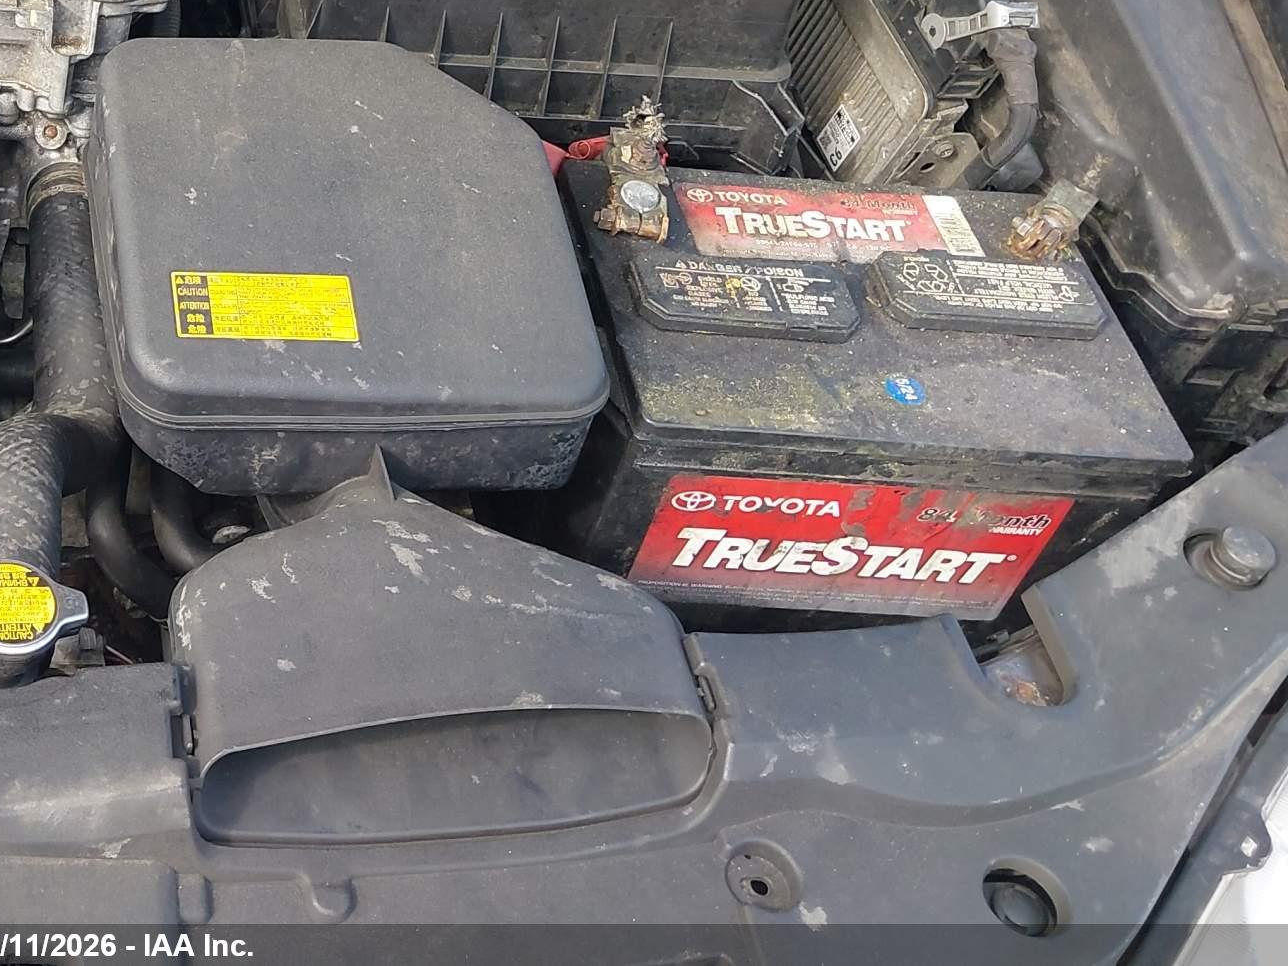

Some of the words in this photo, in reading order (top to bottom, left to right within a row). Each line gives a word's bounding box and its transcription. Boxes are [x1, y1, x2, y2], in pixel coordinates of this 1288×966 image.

[715, 190, 787, 206] TOYOTA
[687, 260, 743, 274] DANGER
[754, 265, 804, 278] POISON
[178, 287, 208, 296] CAUTION
[180, 301, 209, 310] ATTENTION
[721, 495, 841, 518] TOYOTA
